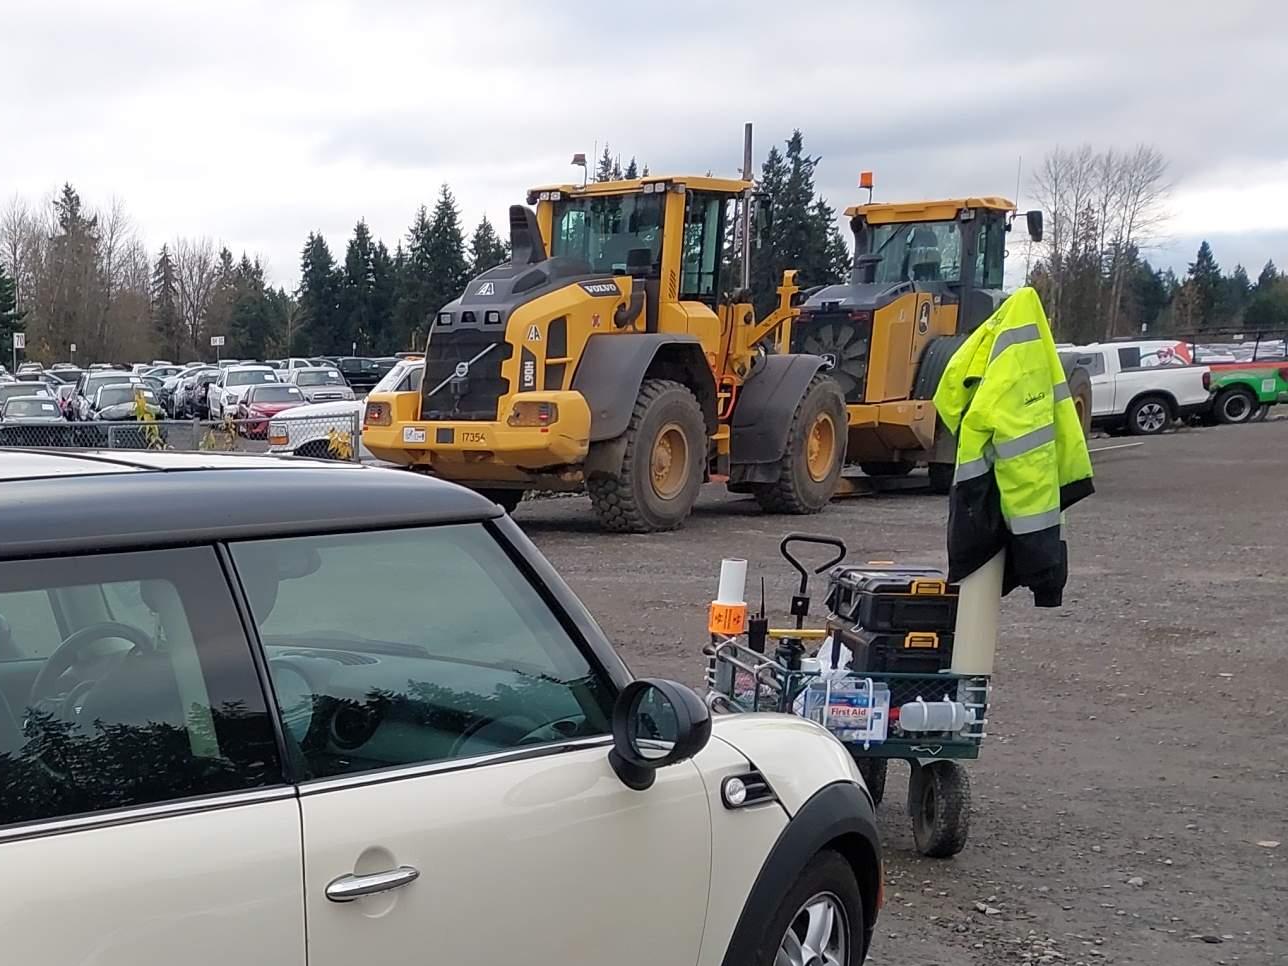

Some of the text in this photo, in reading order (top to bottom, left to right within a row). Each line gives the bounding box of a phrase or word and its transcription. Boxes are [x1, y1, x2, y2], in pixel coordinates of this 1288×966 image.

[584, 284, 617, 293] VOLVO
[524, 361, 534, 387] L90H
[462, 432, 486, 442] 17354
[831, 707, 866, 716] First Aid
